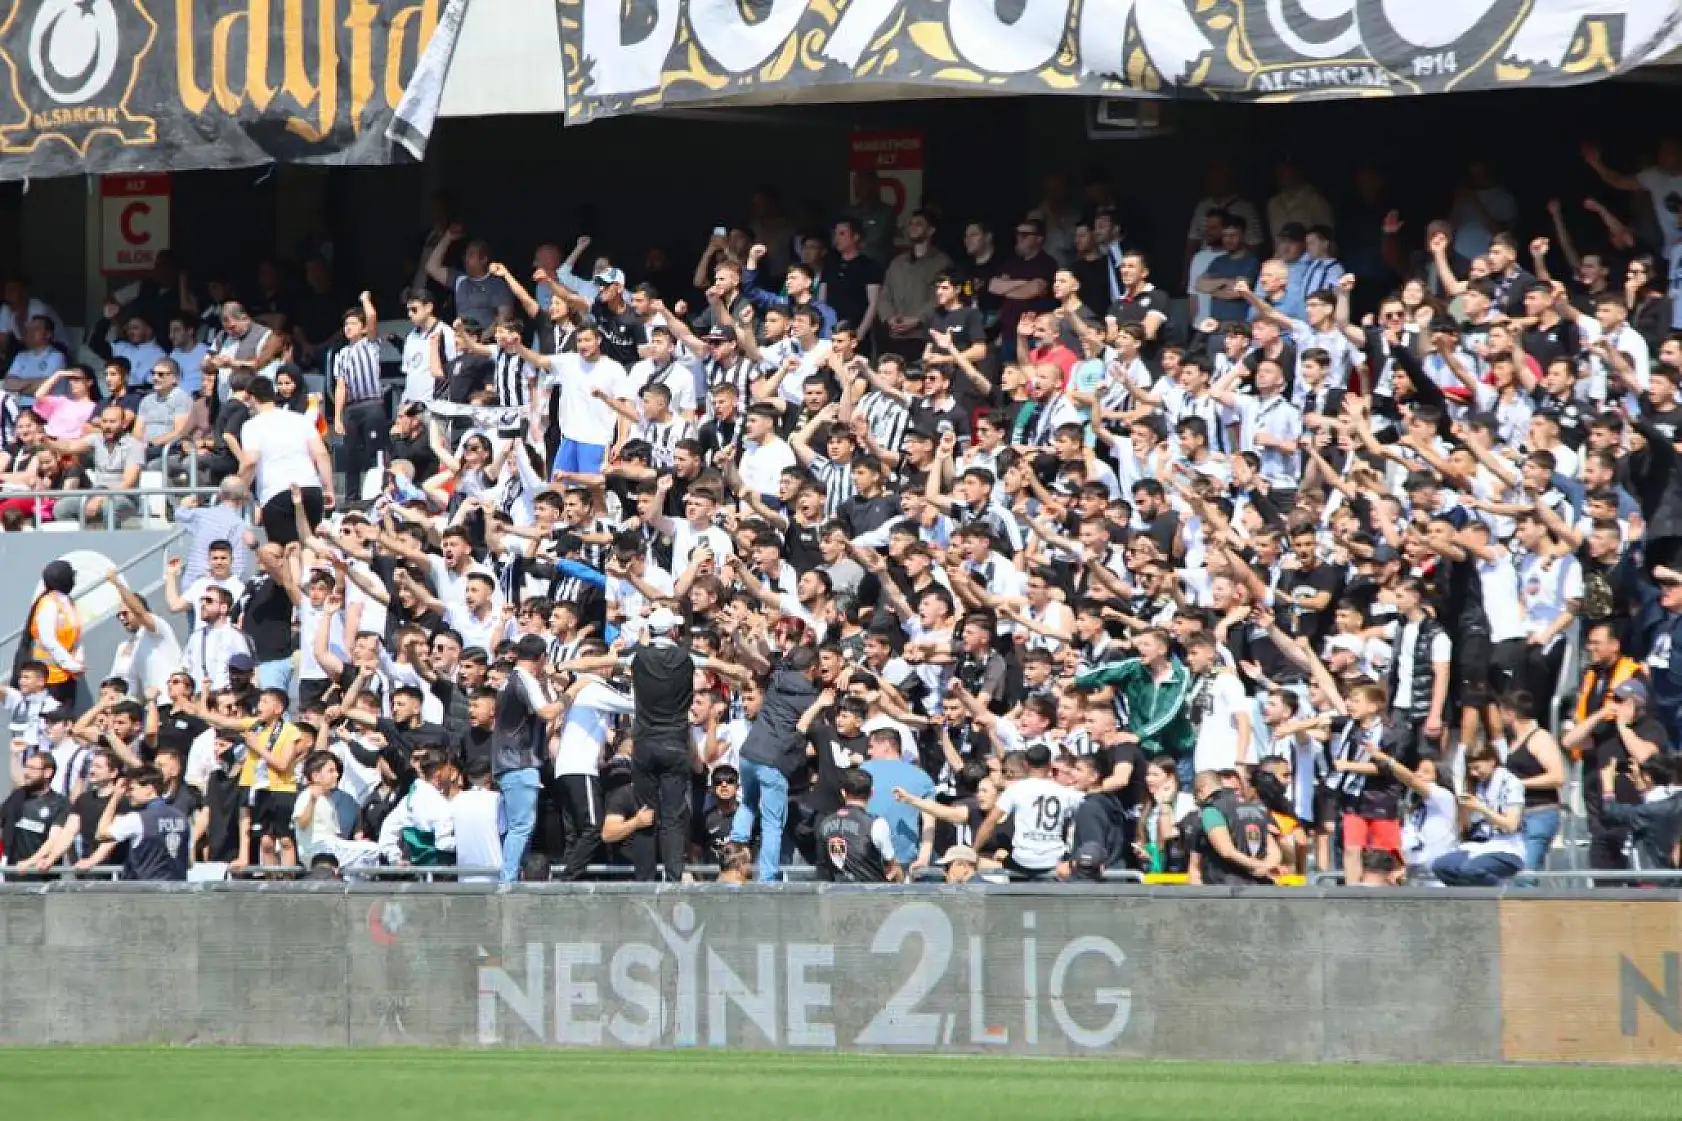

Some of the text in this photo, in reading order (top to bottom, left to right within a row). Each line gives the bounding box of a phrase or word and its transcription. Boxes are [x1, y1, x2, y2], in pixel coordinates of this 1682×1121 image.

[1412, 52, 1458, 76] 1914
[120, 201, 152, 245] C
[1032, 795, 1061, 831] 19
